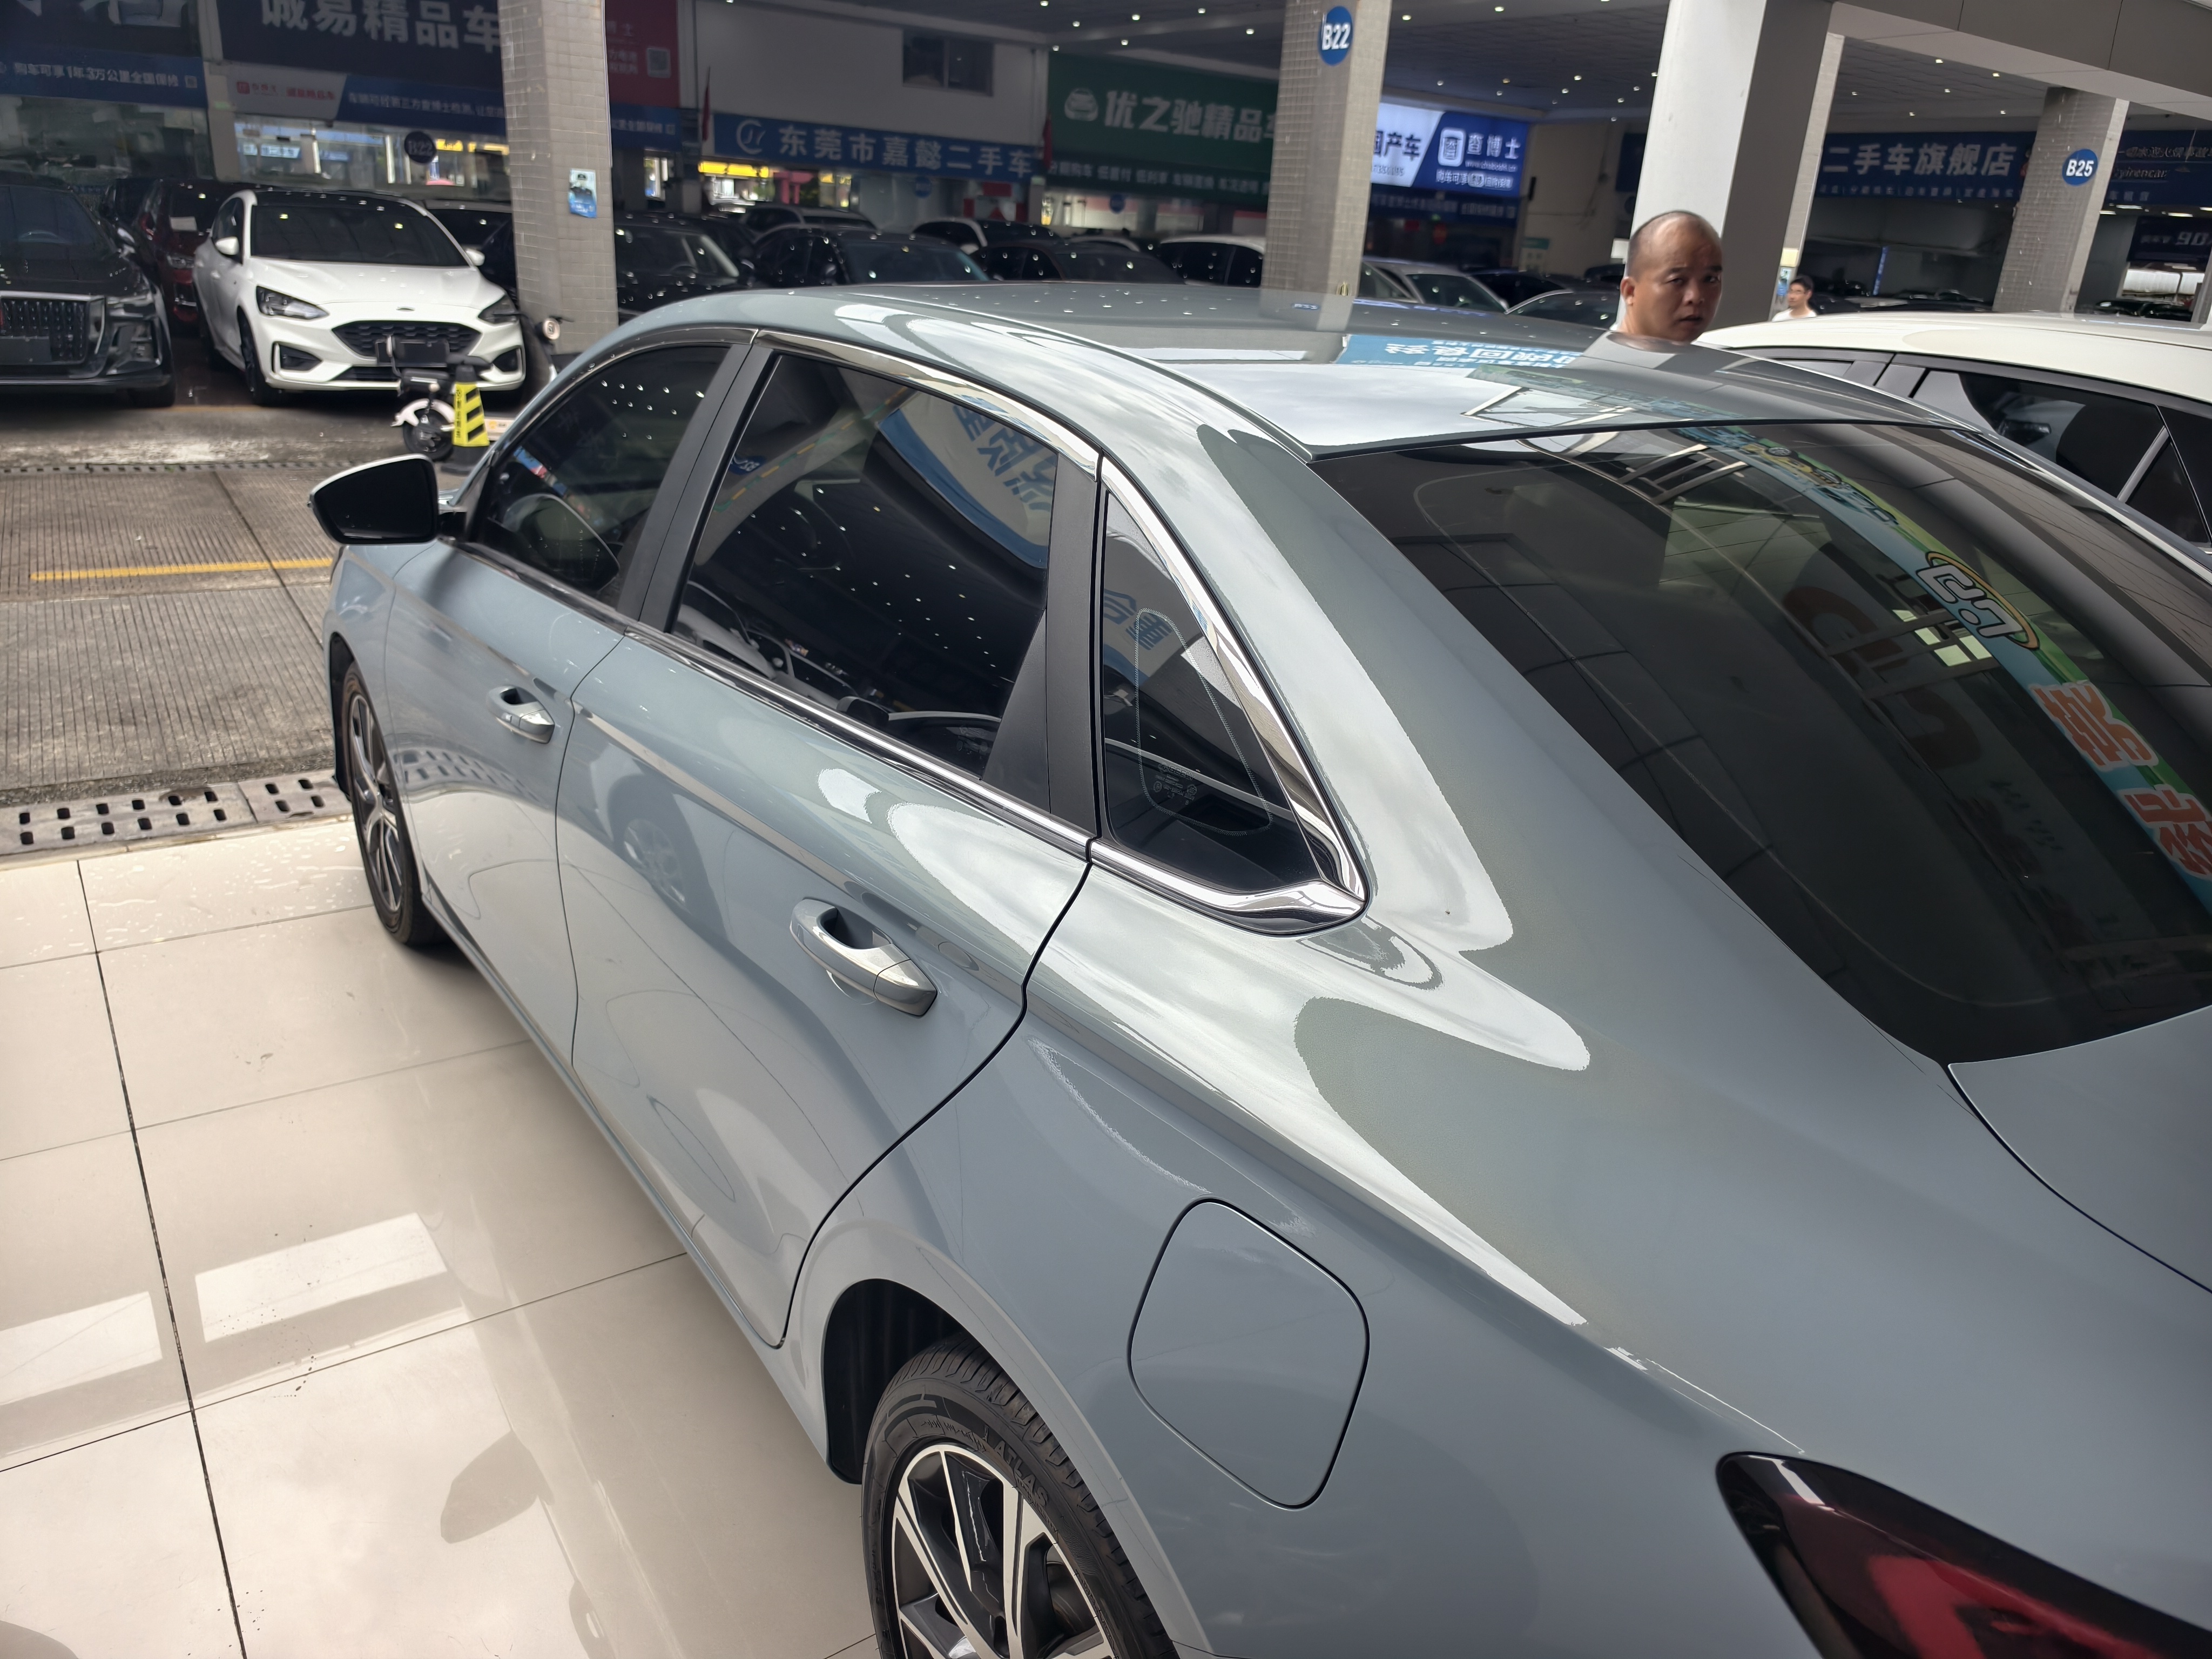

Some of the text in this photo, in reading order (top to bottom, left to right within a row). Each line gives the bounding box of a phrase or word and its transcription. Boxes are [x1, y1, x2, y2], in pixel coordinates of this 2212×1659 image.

[1321, 24, 1350, 50] B22
[778, 124, 1032, 179] 东莞市嘉懿二手车
[1466, 132, 1521, 160] 查博士
[1823, 143, 2017, 177] 二手车旗舰店
[2066, 158, 2095, 178] B25
